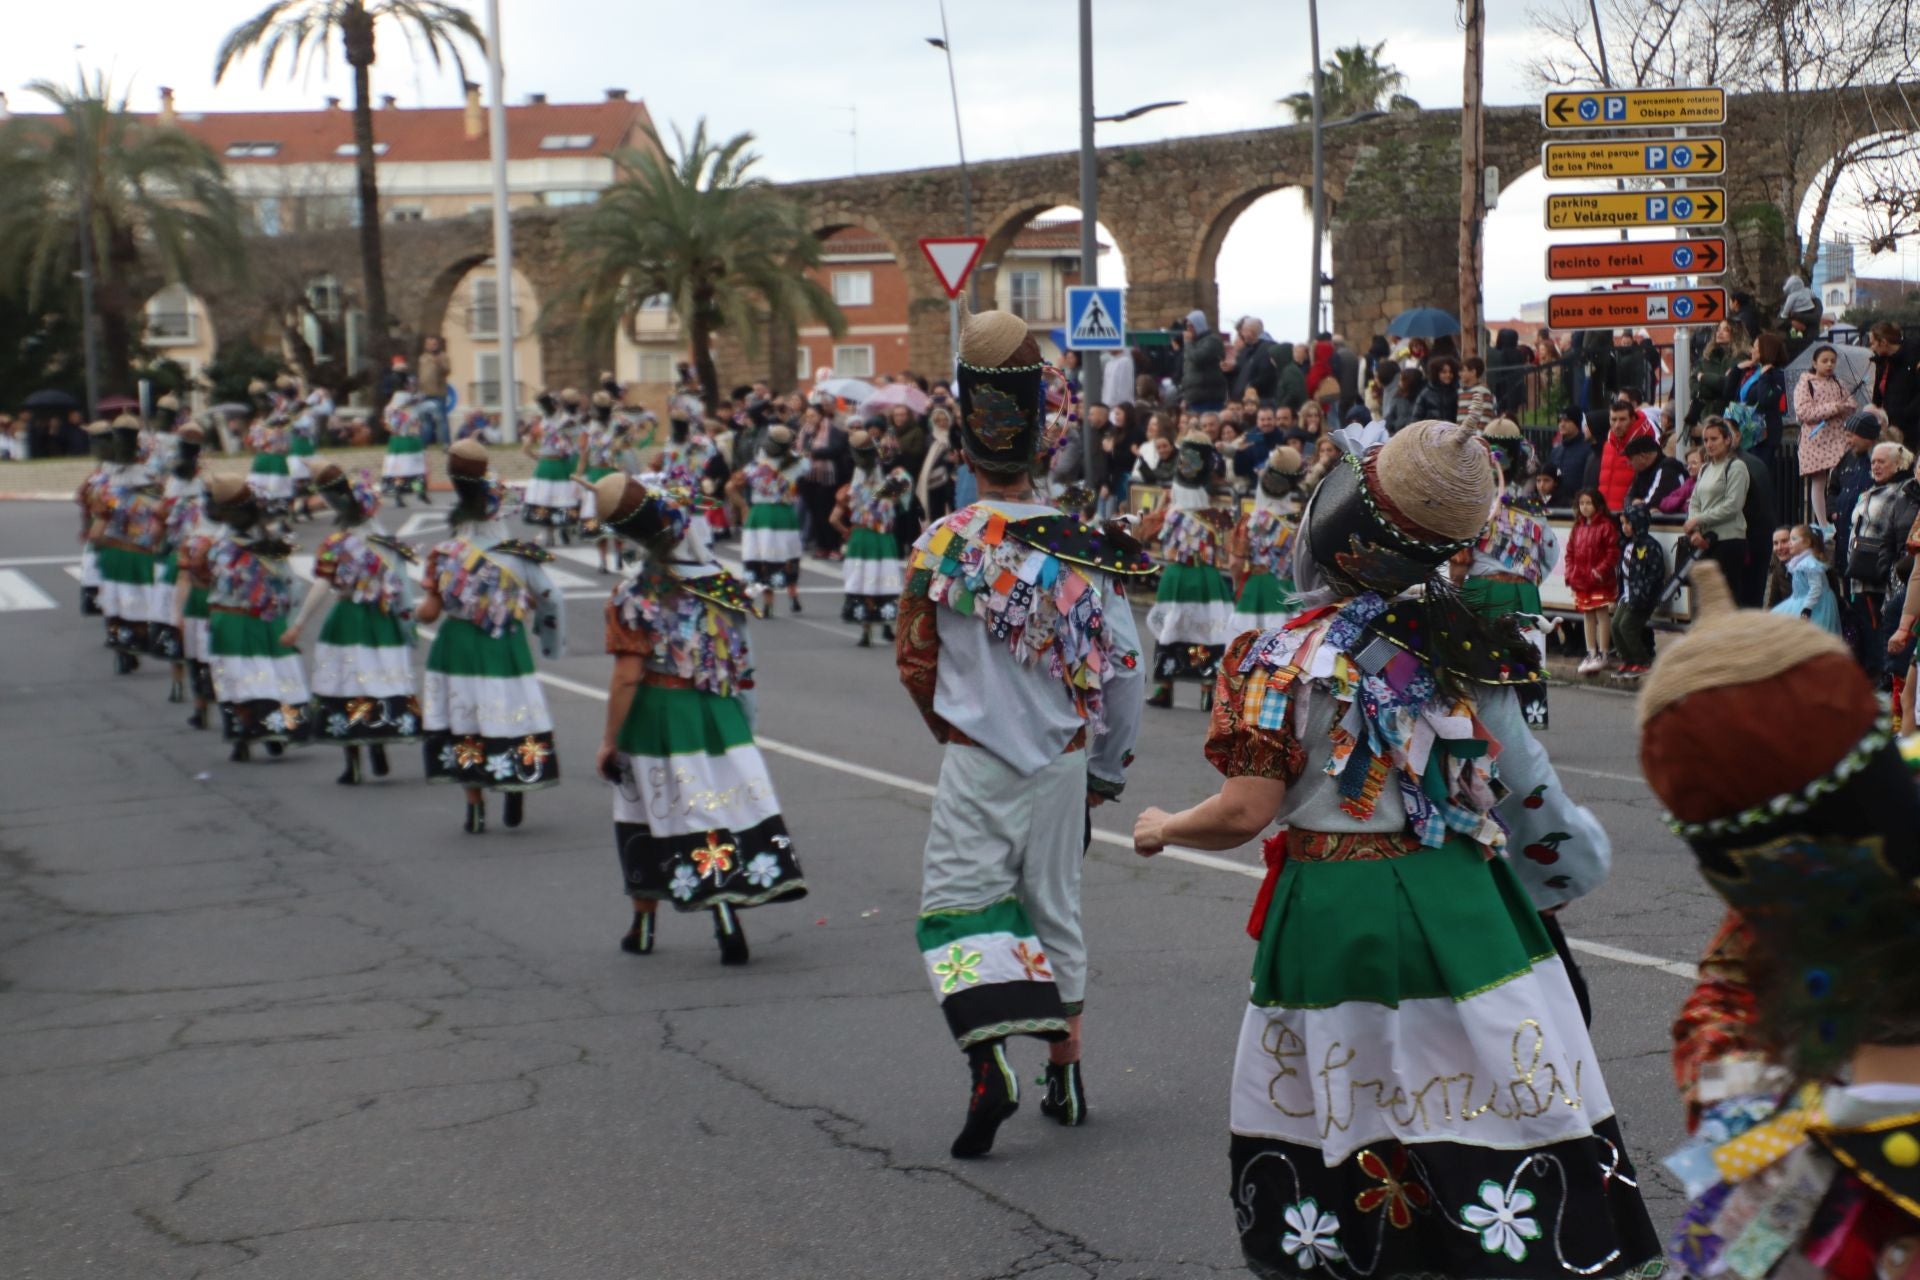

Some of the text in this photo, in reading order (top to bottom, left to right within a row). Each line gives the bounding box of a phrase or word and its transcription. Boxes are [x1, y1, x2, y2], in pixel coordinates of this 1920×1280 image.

[1687, 95, 1720, 104] rotatorio
[1608, 98, 1623, 120] P
[1640, 106, 1720, 118] Obispo Amadeo
[1552, 149, 1640, 161] parking del parque
[1650, 147, 1665, 169] P
[1552, 161, 1613, 172] de los Pinos
[1553, 197, 1598, 210] parking
[1650, 199, 1665, 220] P
[1553, 210, 1639, 224] c/ Velázquez
[1553, 254, 1644, 269] recinto ferial
[1553, 304, 1639, 319] plaza de toros
